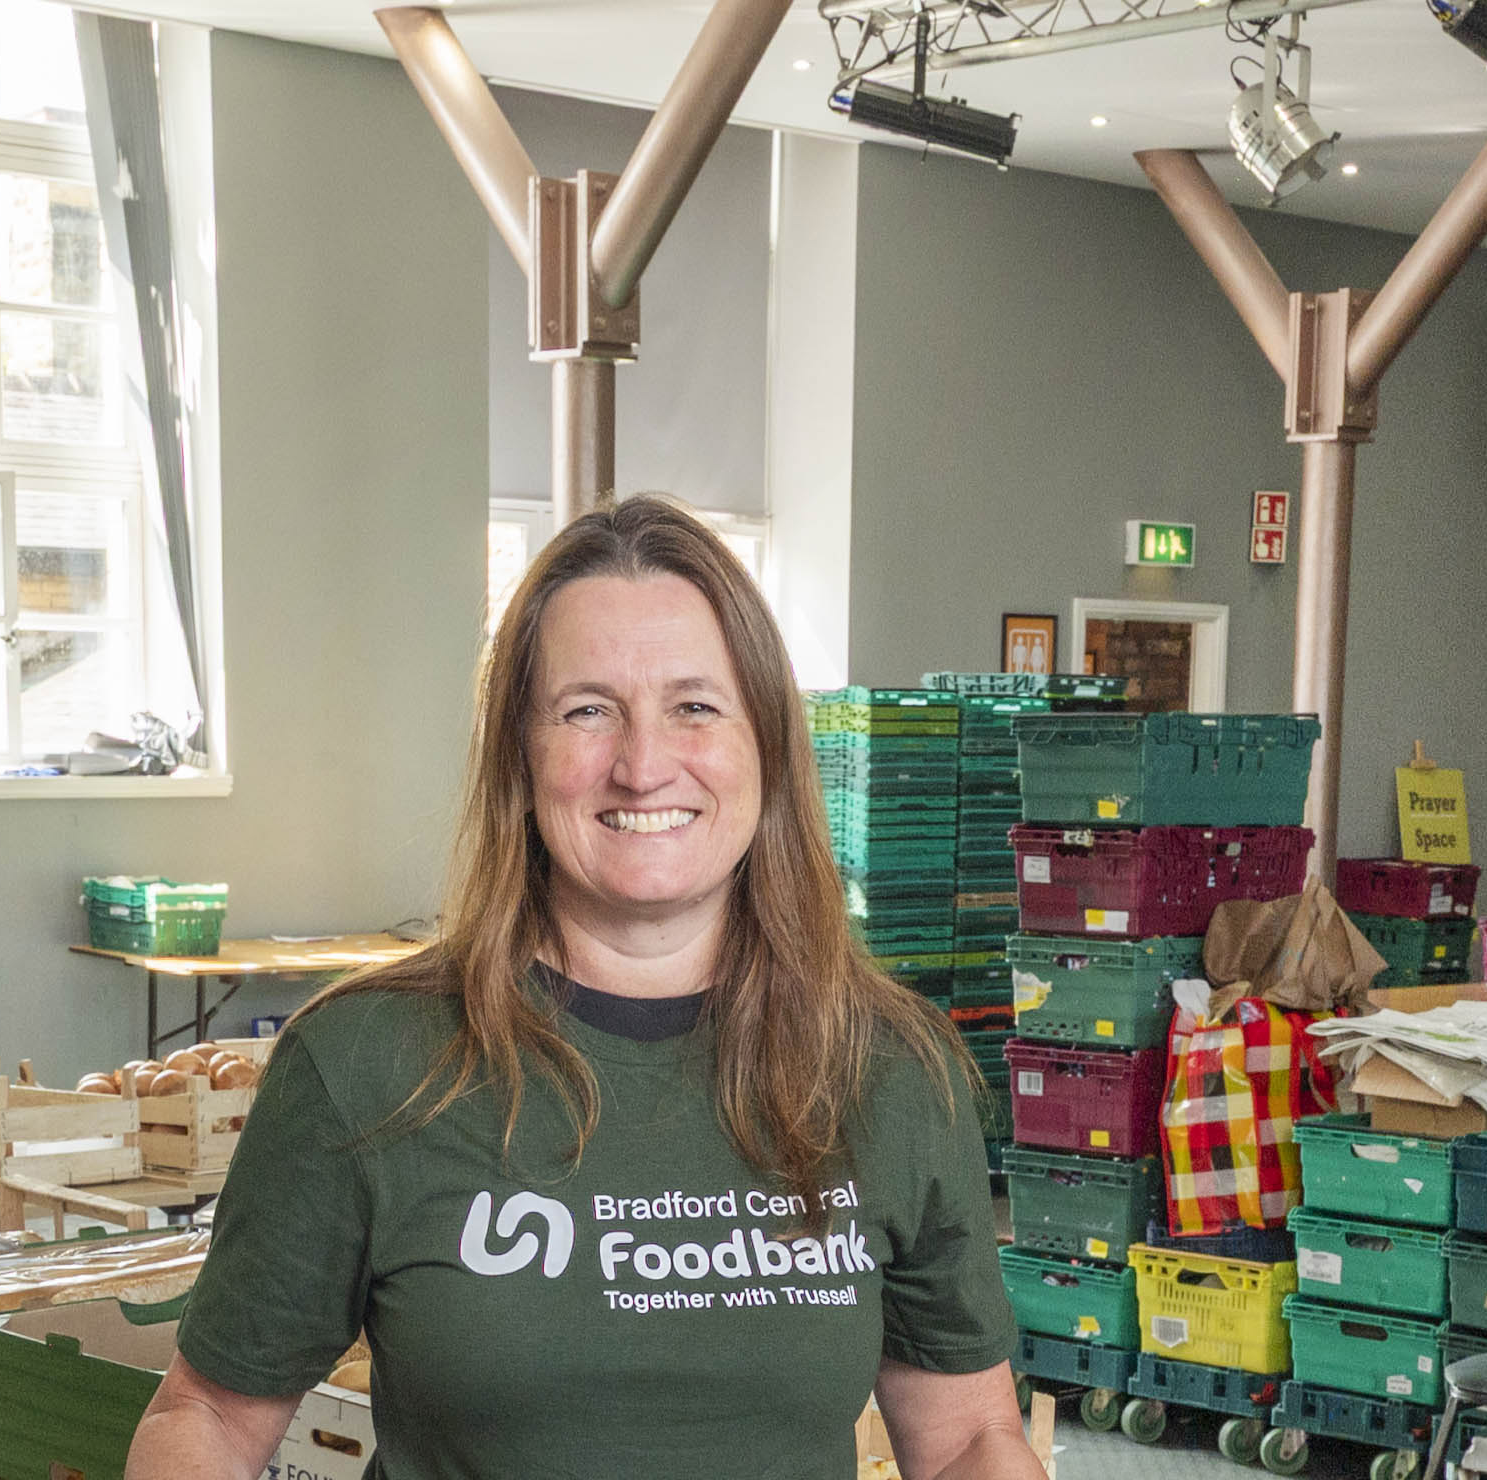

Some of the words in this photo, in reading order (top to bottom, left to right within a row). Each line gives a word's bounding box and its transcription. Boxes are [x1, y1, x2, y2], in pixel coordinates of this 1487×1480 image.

[1409, 792, 1457, 814] Prayer
[1415, 829, 1457, 852] Space
[593, 1190, 738, 1220] Bradford
[745, 1181, 859, 1217] Cenral
[599, 1219, 876, 1281] Foodbank
[603, 1290, 715, 1314] Together
[721, 1286, 777, 1308] with
[780, 1285, 858, 1305] Trussell
